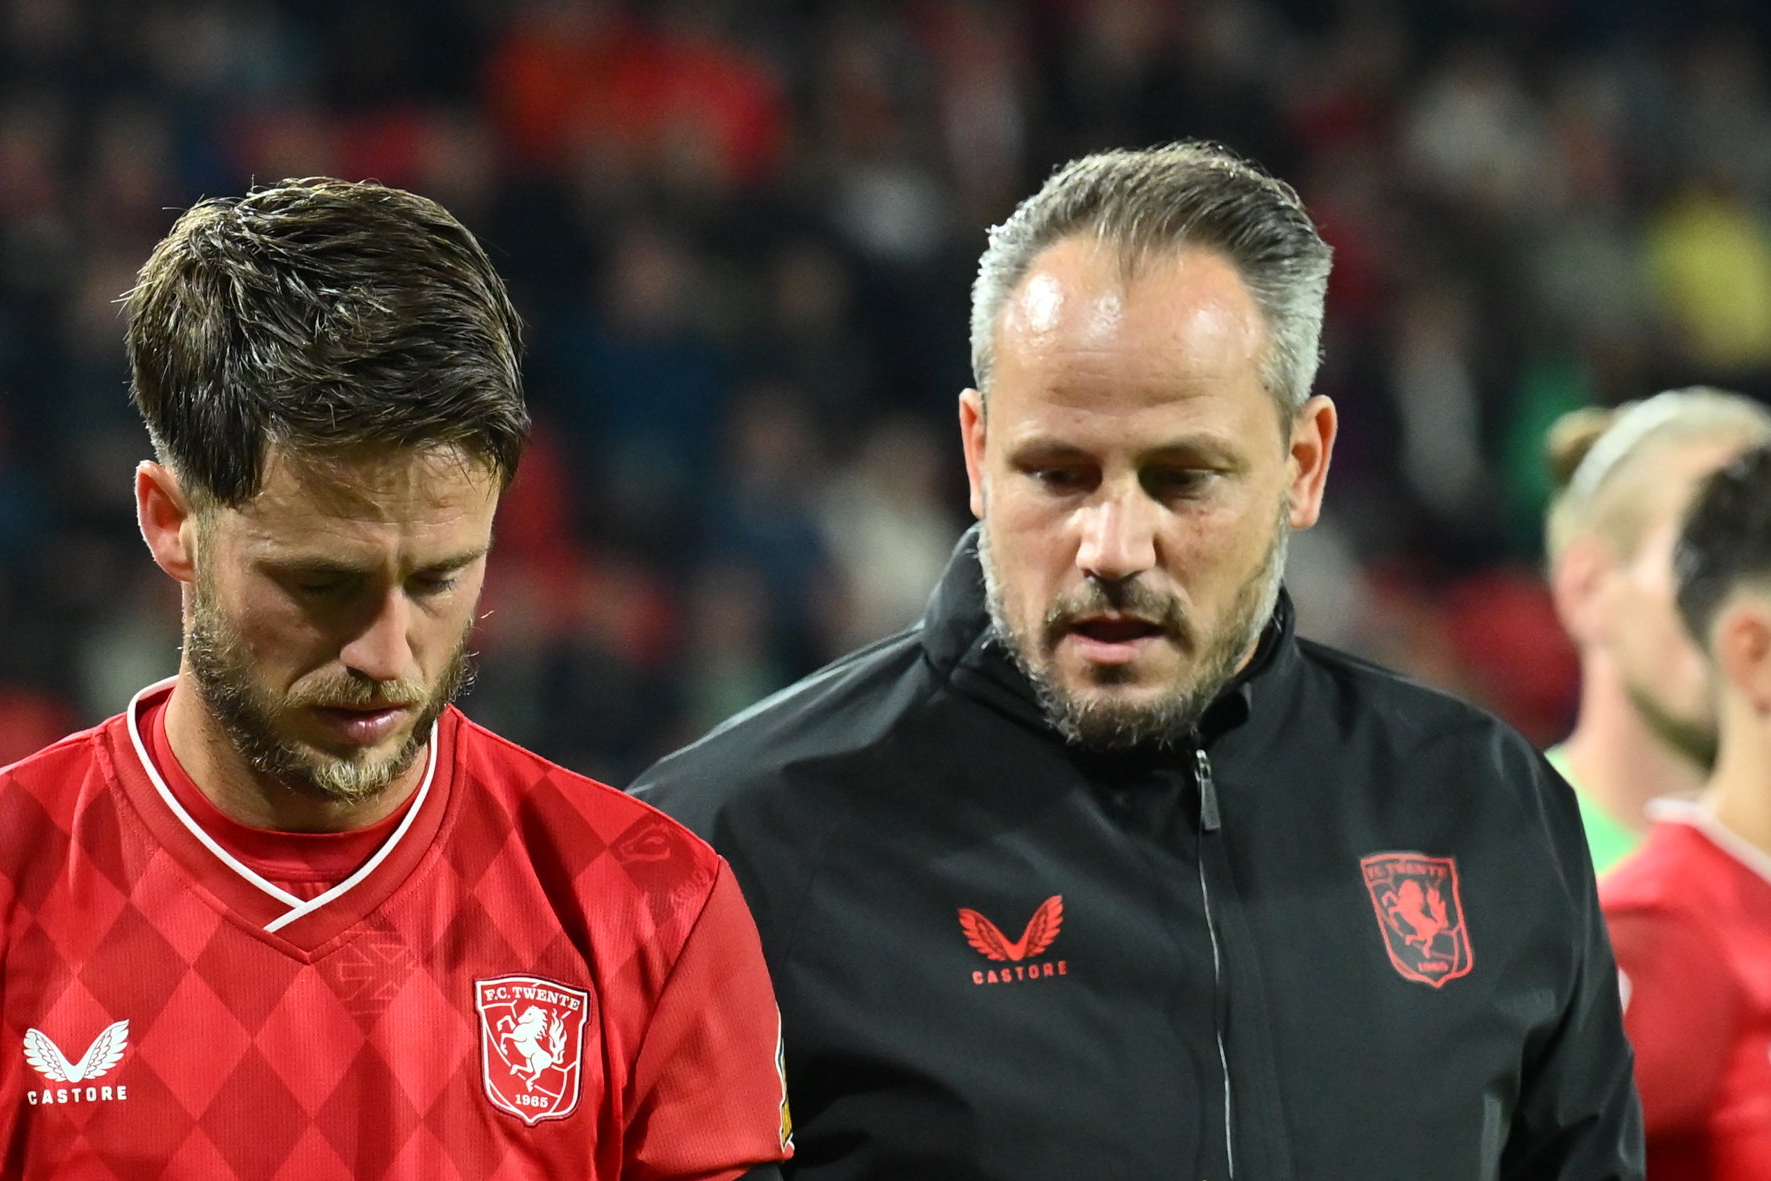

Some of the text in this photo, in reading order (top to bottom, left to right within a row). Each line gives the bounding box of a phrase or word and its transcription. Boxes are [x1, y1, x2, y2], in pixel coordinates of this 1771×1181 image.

[972, 960, 1067, 985] CASTORE
[484, 986, 581, 1011] F.C. TWENTE
[27, 1085, 128, 1106] CASTORE
[515, 1094, 549, 1108] 1965
